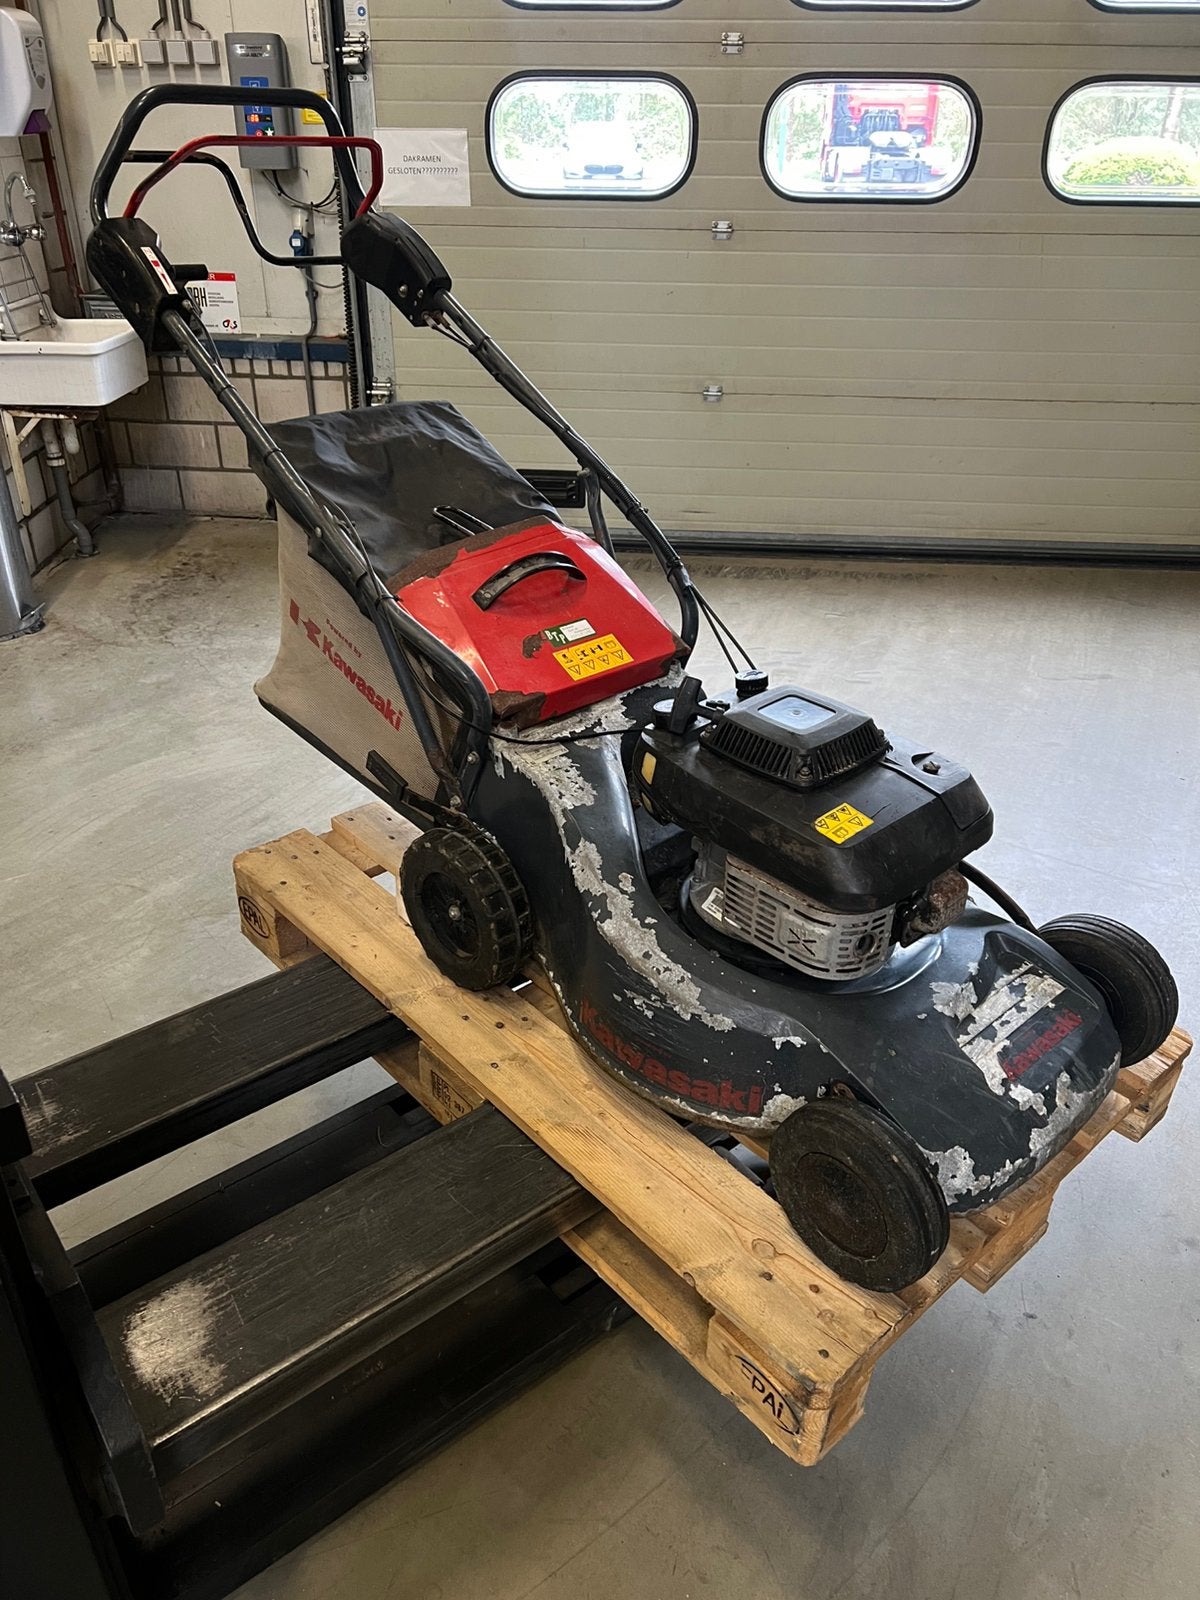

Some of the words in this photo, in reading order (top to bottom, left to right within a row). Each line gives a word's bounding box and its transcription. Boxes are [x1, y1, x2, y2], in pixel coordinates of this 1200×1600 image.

[403, 154, 441, 163] DAKRAMEN
[544, 630, 566, 644] BTP
[322, 634, 403, 731] Kawasaki
[579, 1000, 764, 1116] Kawasaki
